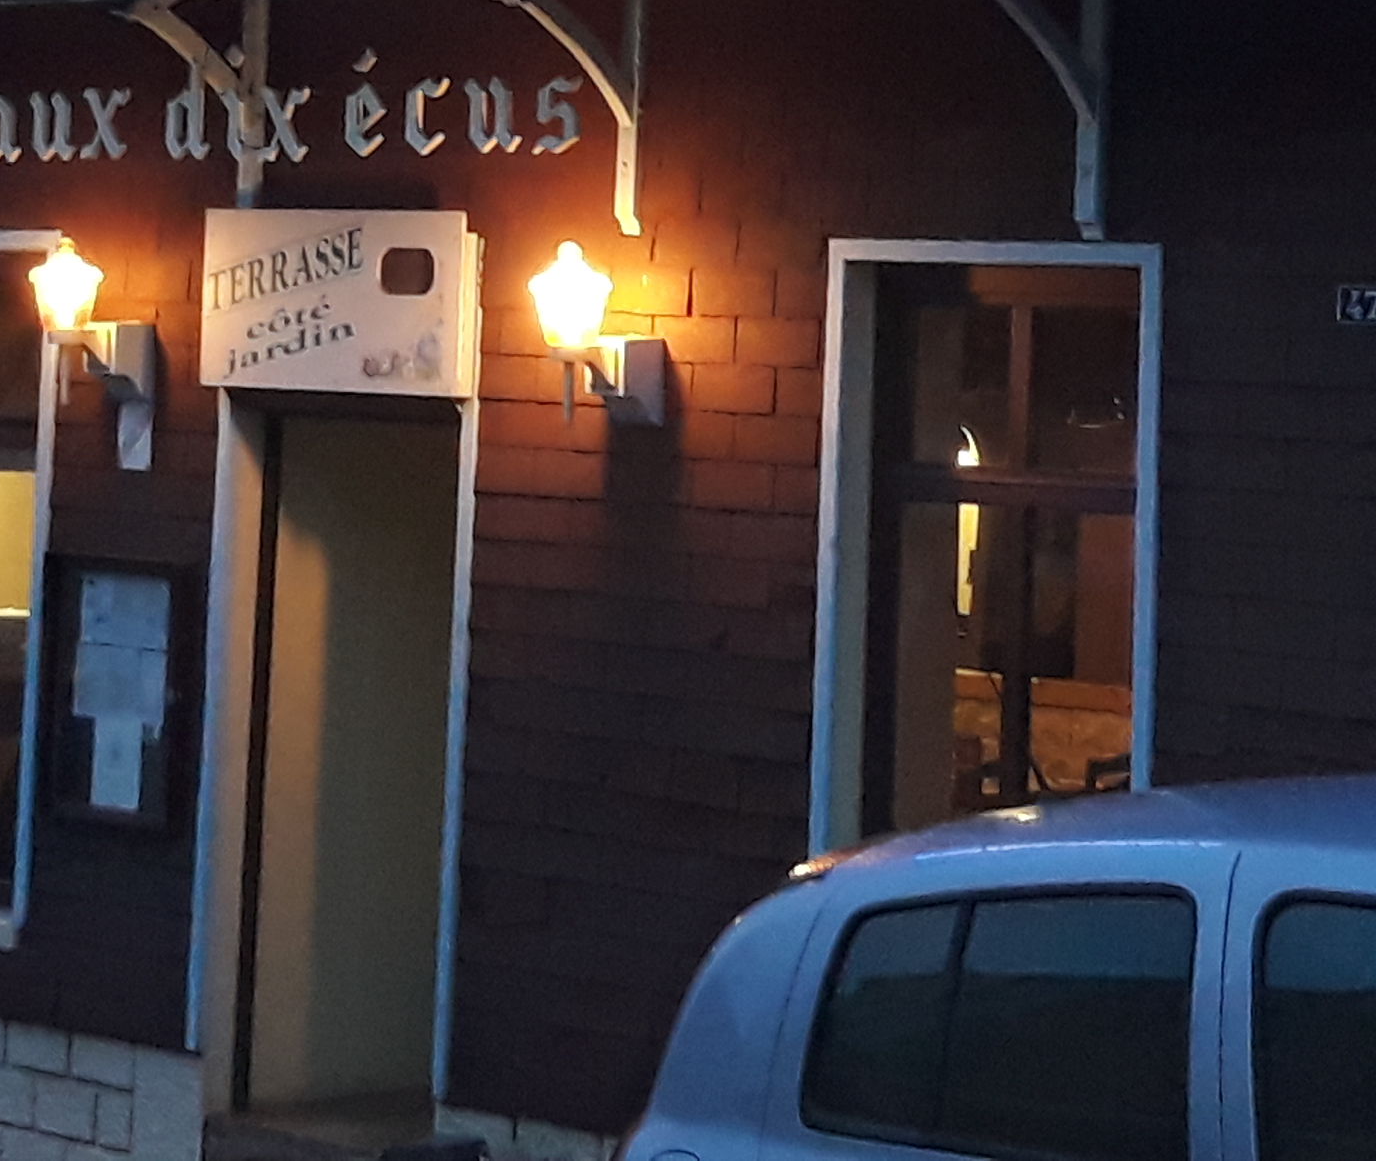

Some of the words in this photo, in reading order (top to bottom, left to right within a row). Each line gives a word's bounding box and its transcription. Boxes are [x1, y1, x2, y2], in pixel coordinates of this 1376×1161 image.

[165, 45, 311, 164] dix
[344, 48, 584, 158] écus
[208, 226, 365, 311] TERRASSE
[223, 321, 356, 380] jardin
